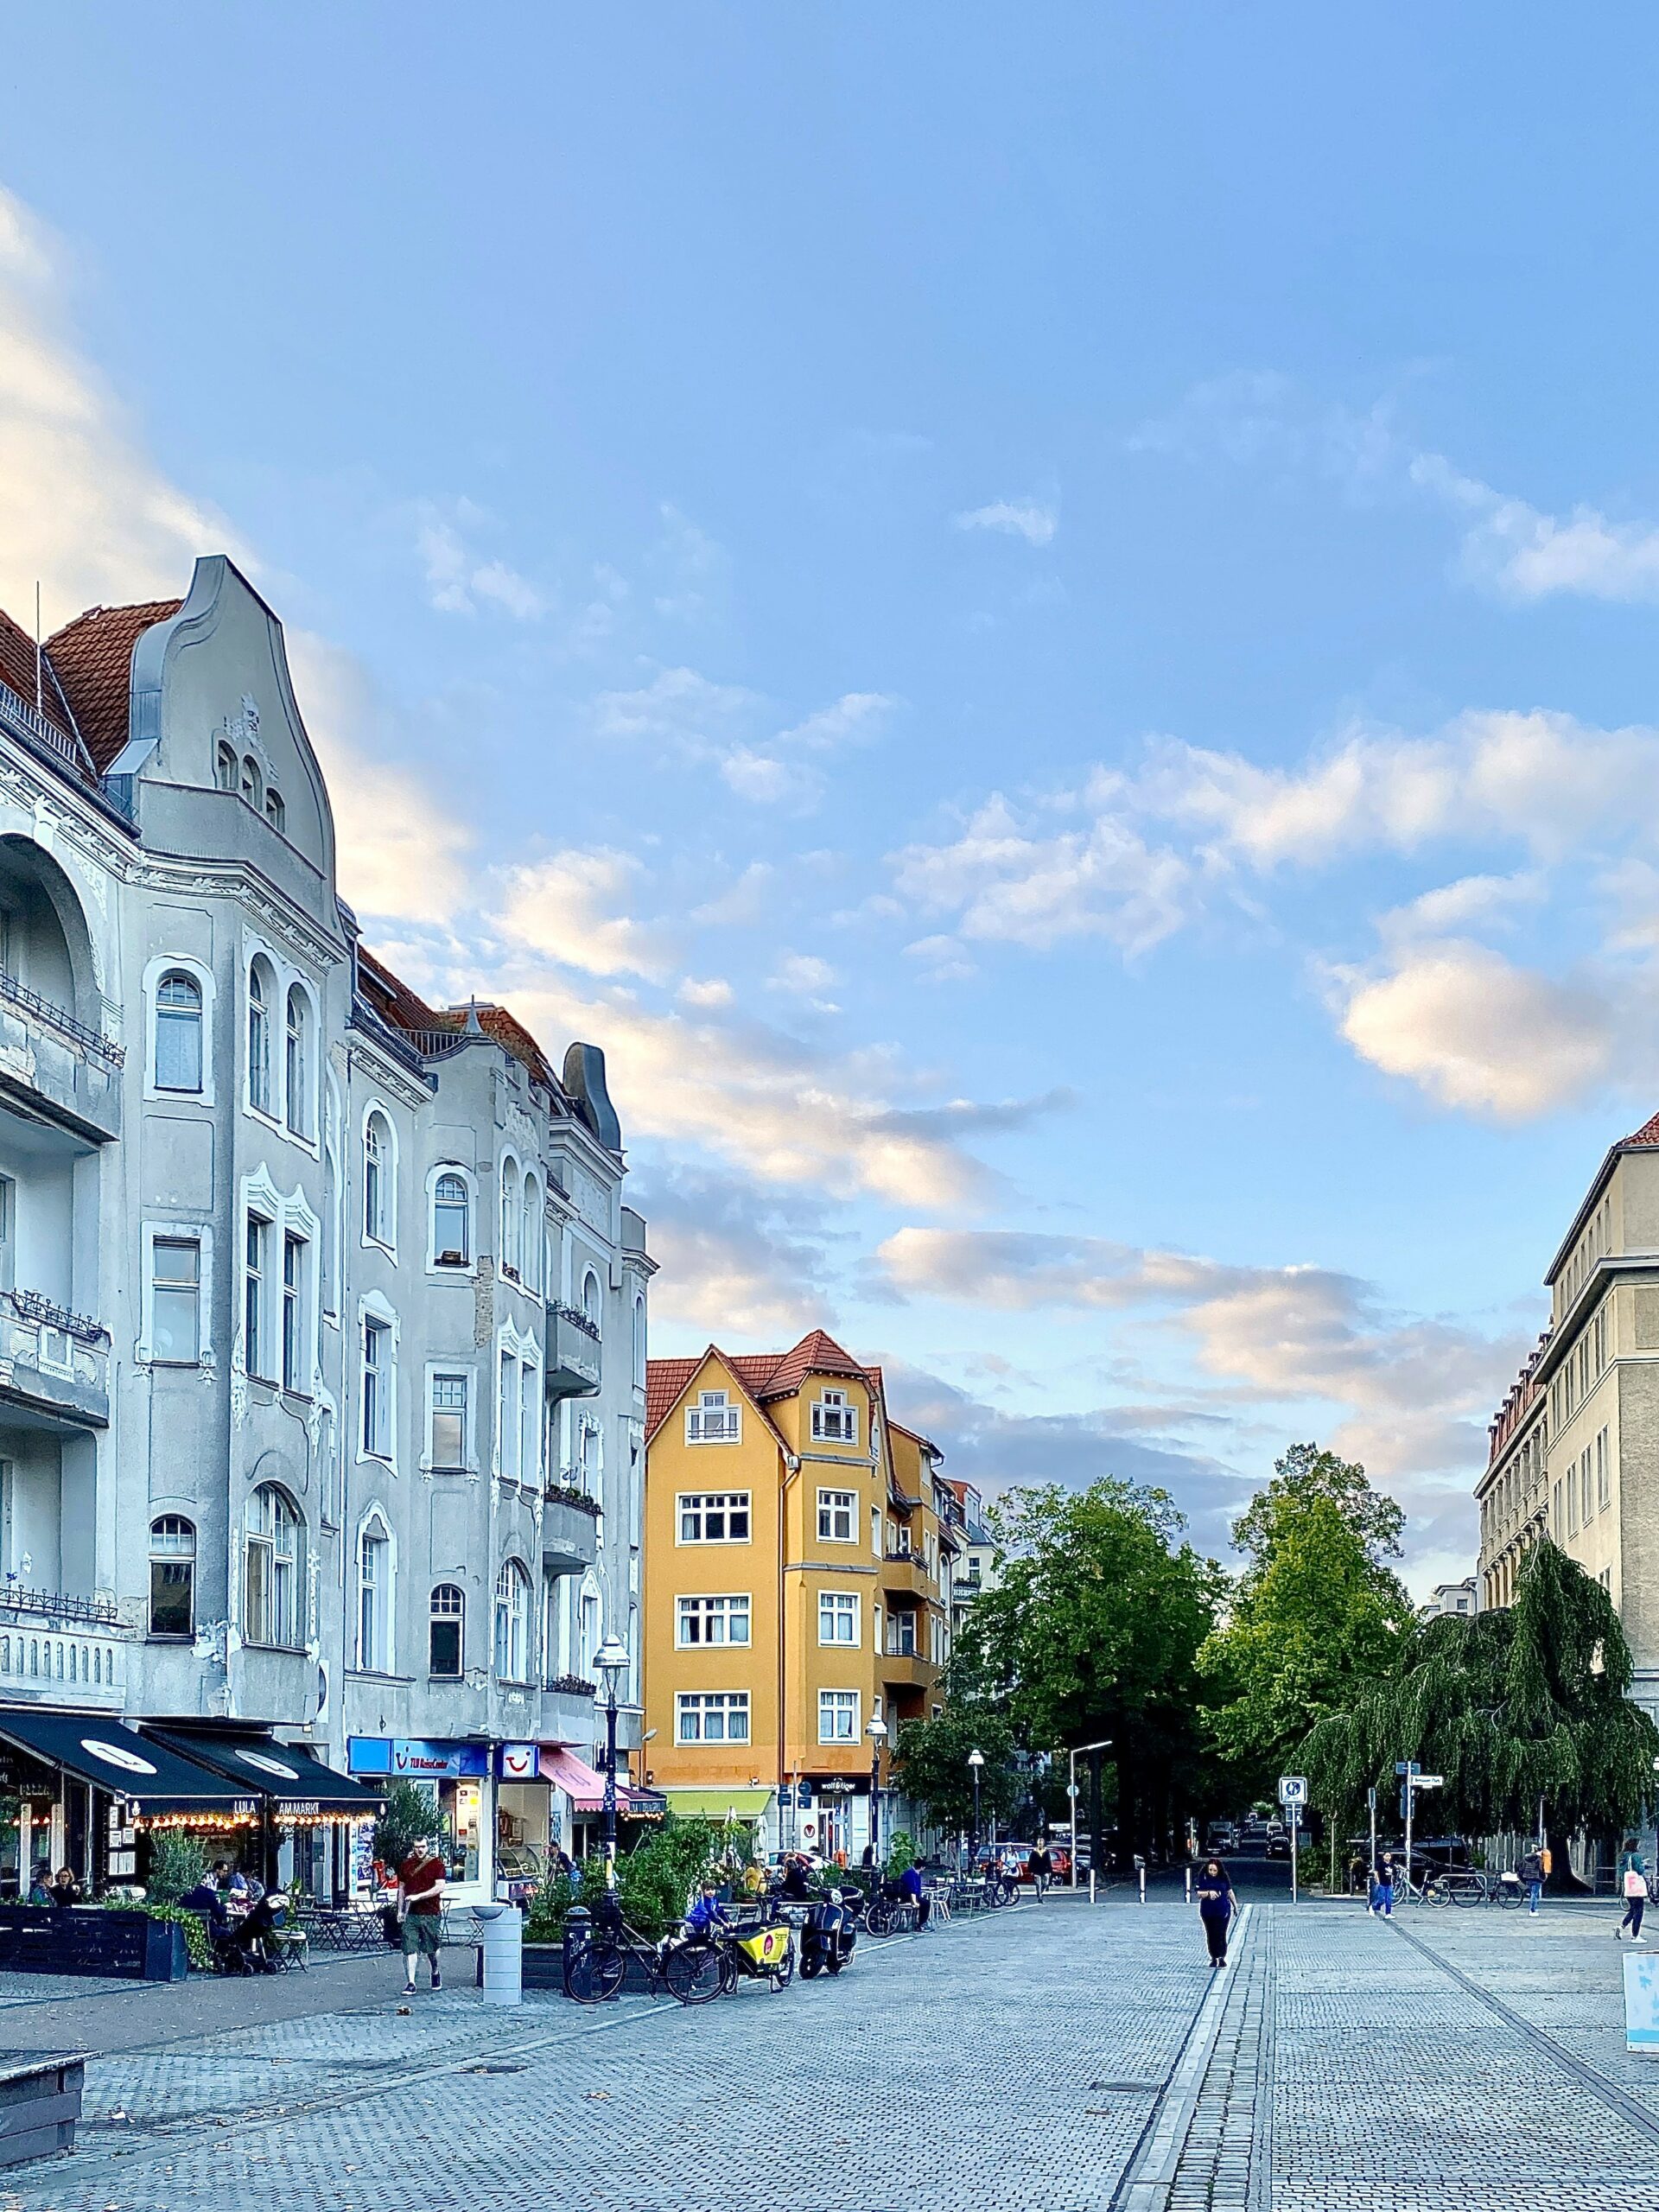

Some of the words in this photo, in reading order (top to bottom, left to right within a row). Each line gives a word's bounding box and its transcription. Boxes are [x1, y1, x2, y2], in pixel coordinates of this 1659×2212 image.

[234, 1800, 256, 1814] LULA
[279, 1802, 292, 1815] AM
[293, 1802, 320, 1815] MARKT
